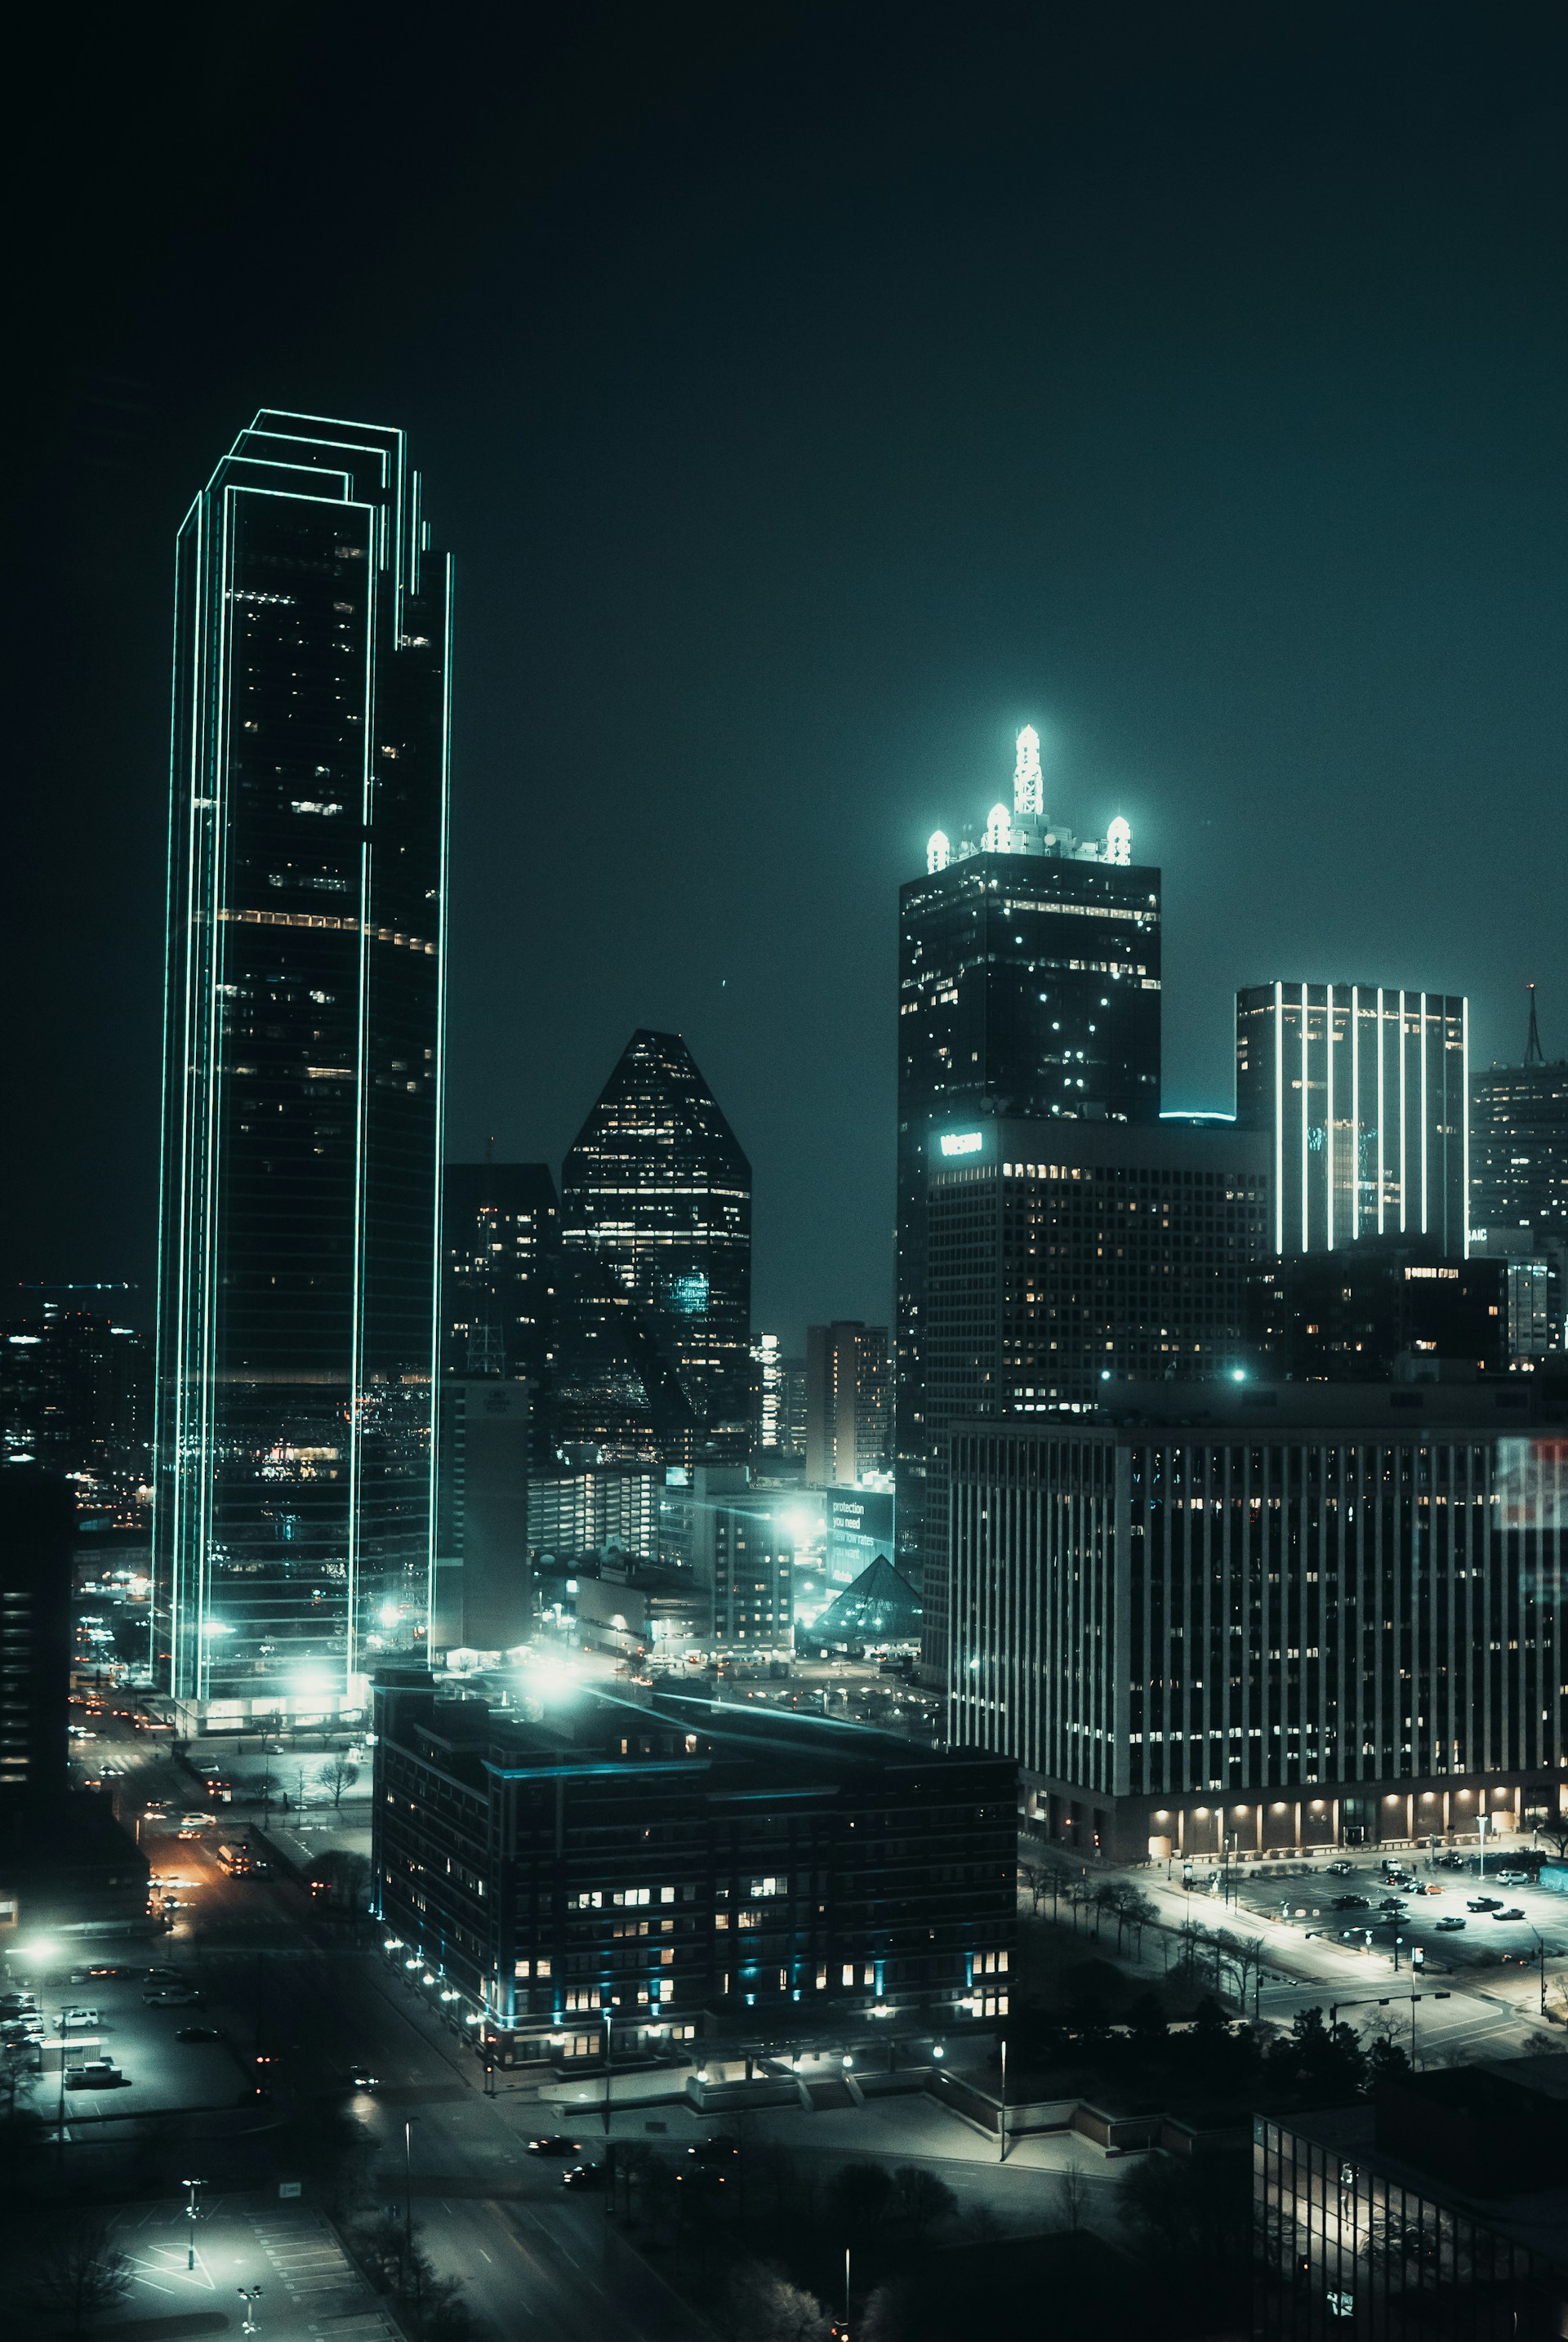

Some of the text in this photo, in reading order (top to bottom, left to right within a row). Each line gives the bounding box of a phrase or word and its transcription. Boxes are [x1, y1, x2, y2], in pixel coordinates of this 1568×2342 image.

[833, 1502, 864, 1515] protection
[833, 1517, 860, 1529] you need
[833, 1531, 845, 1542] new
[858, 1534, 874, 1547] rates
[844, 1548, 860, 1560] want
